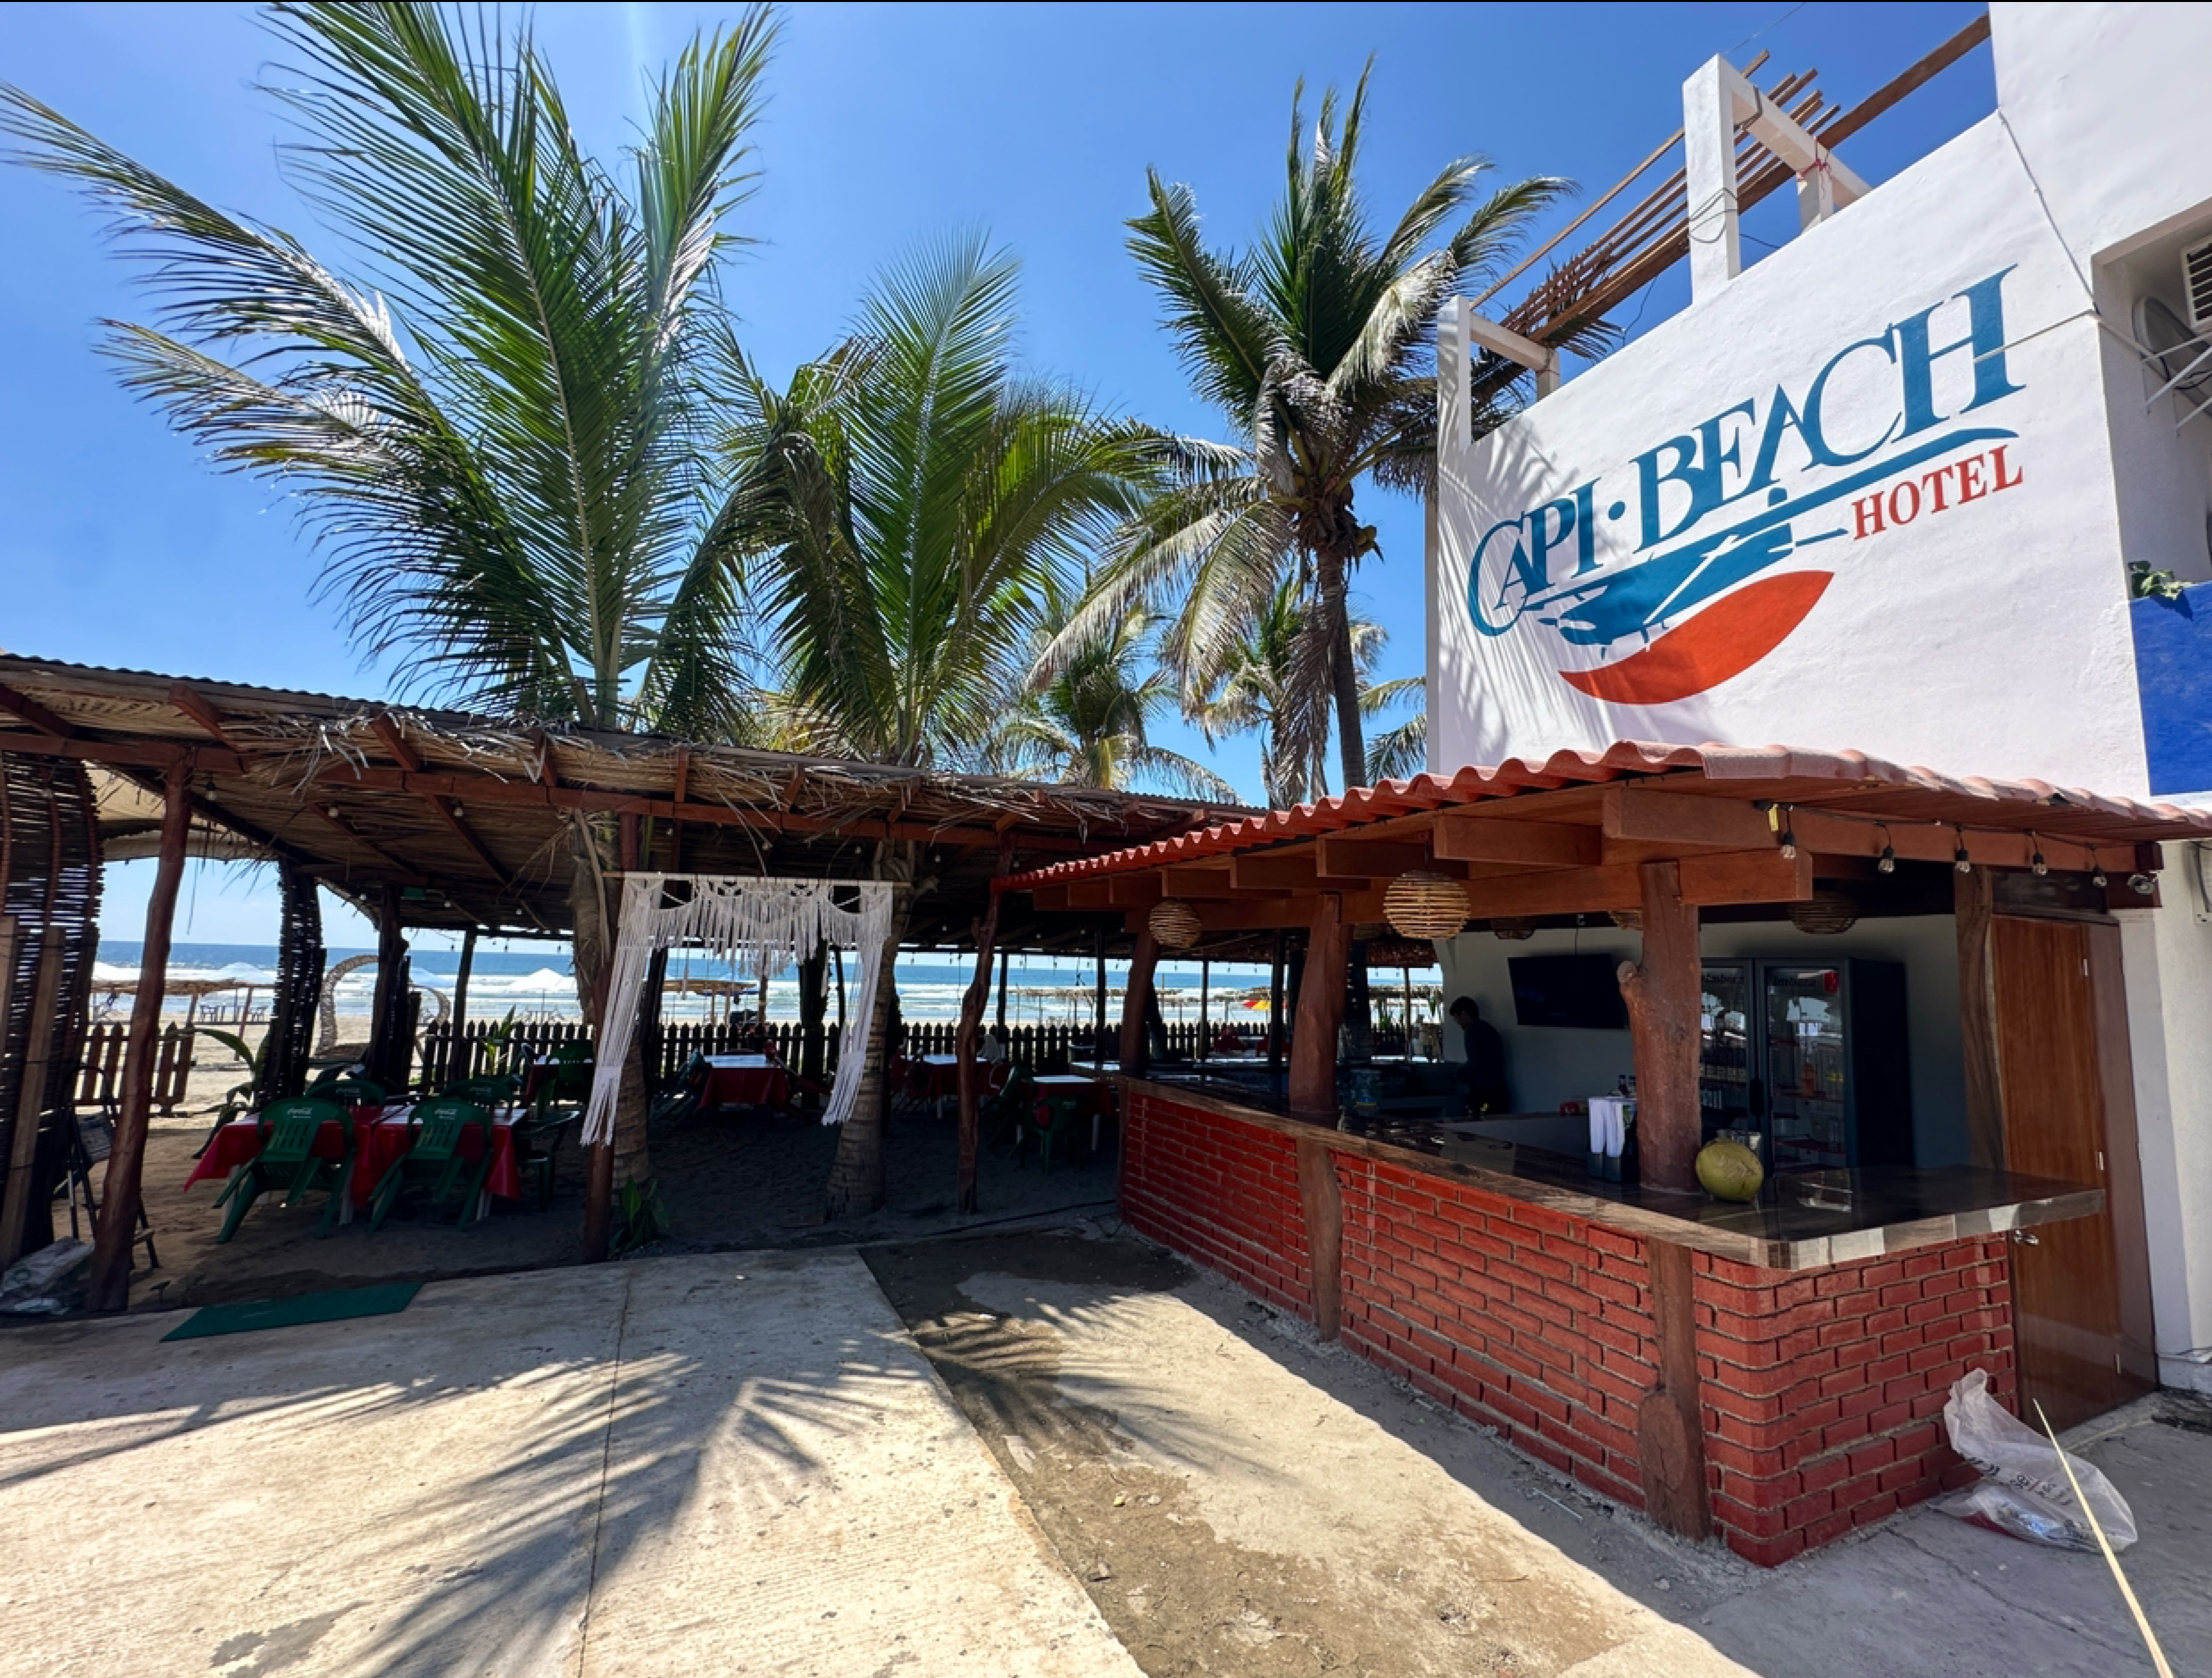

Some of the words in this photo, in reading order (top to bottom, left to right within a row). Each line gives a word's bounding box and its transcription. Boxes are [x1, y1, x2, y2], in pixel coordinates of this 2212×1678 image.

[1468, 477, 1604, 636] CAPI
[1629, 264, 2026, 553] BEACH
[1853, 446, 2023, 539] HOTEL
